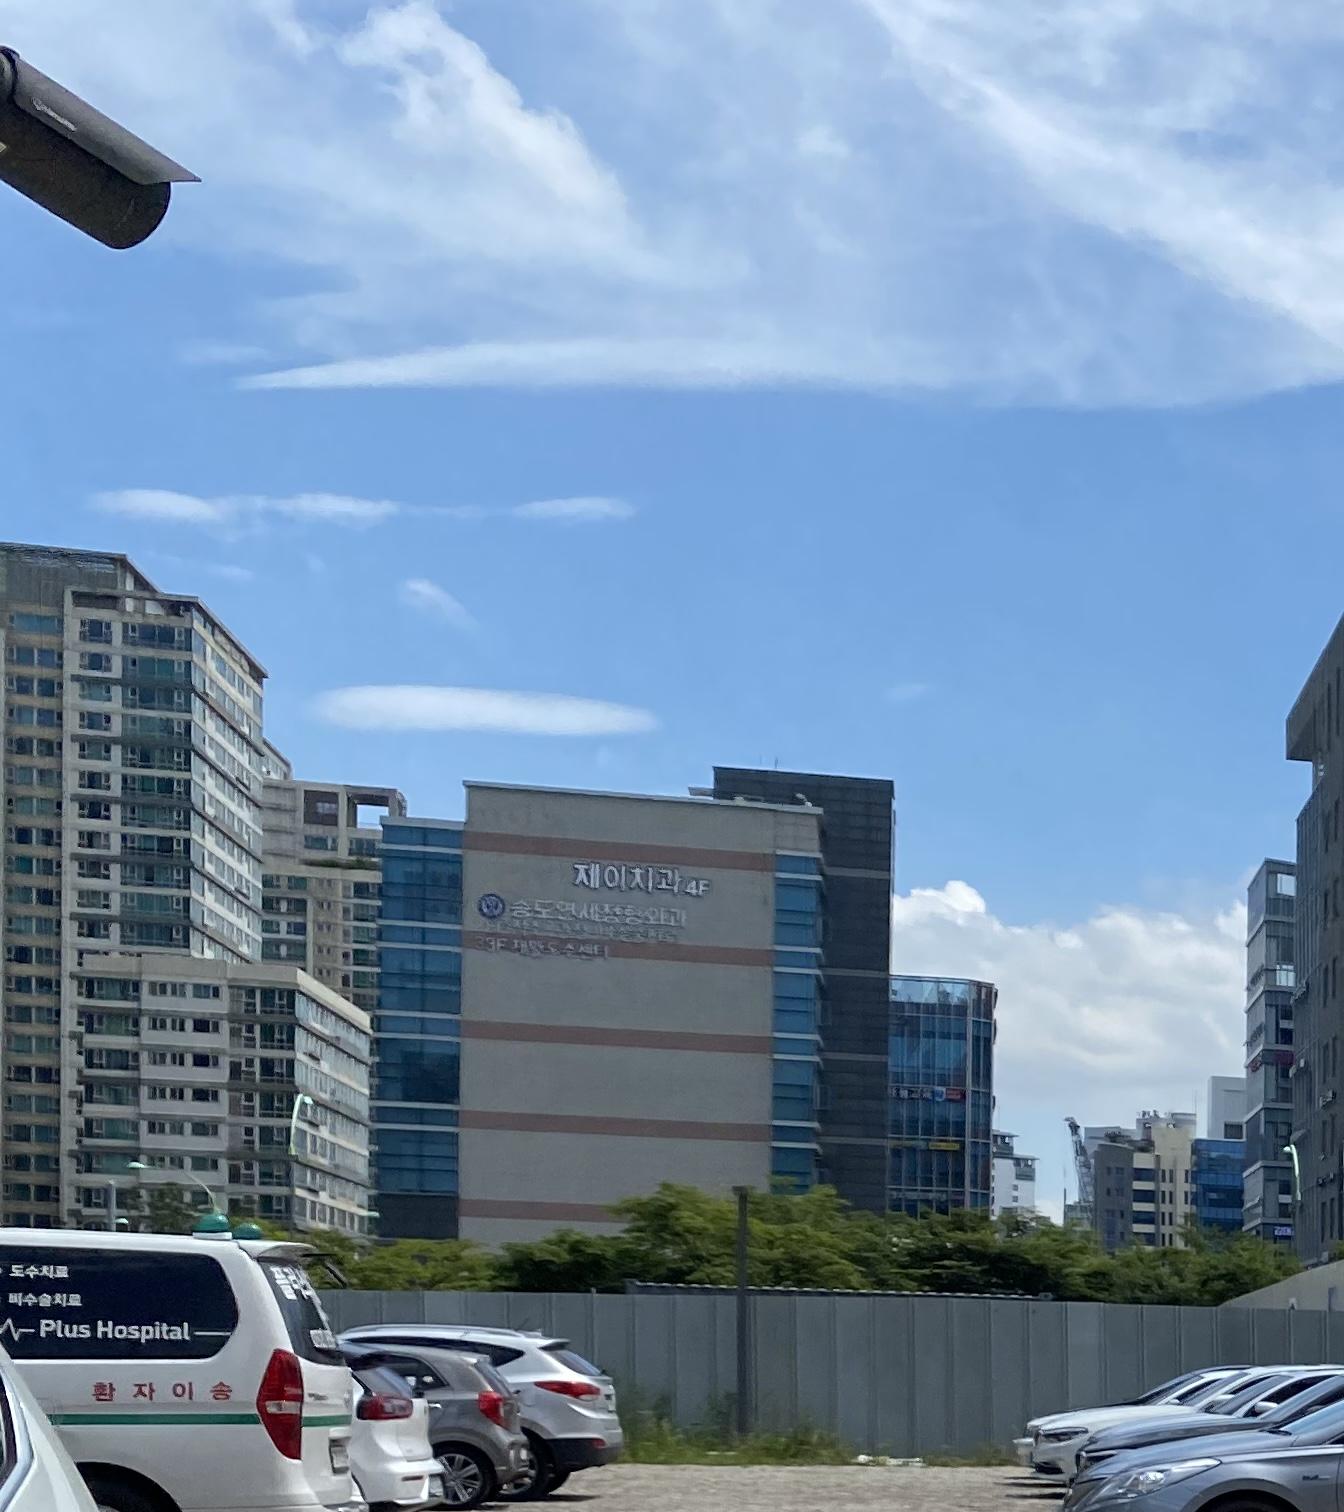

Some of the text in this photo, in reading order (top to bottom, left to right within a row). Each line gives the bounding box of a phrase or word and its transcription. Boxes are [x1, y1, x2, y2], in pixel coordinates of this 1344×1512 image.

[573, 862, 680, 894] 제이치과
[9, 1264, 70, 1279] 도수치료
[39, 1319, 191, 1343] Plus Hospital
